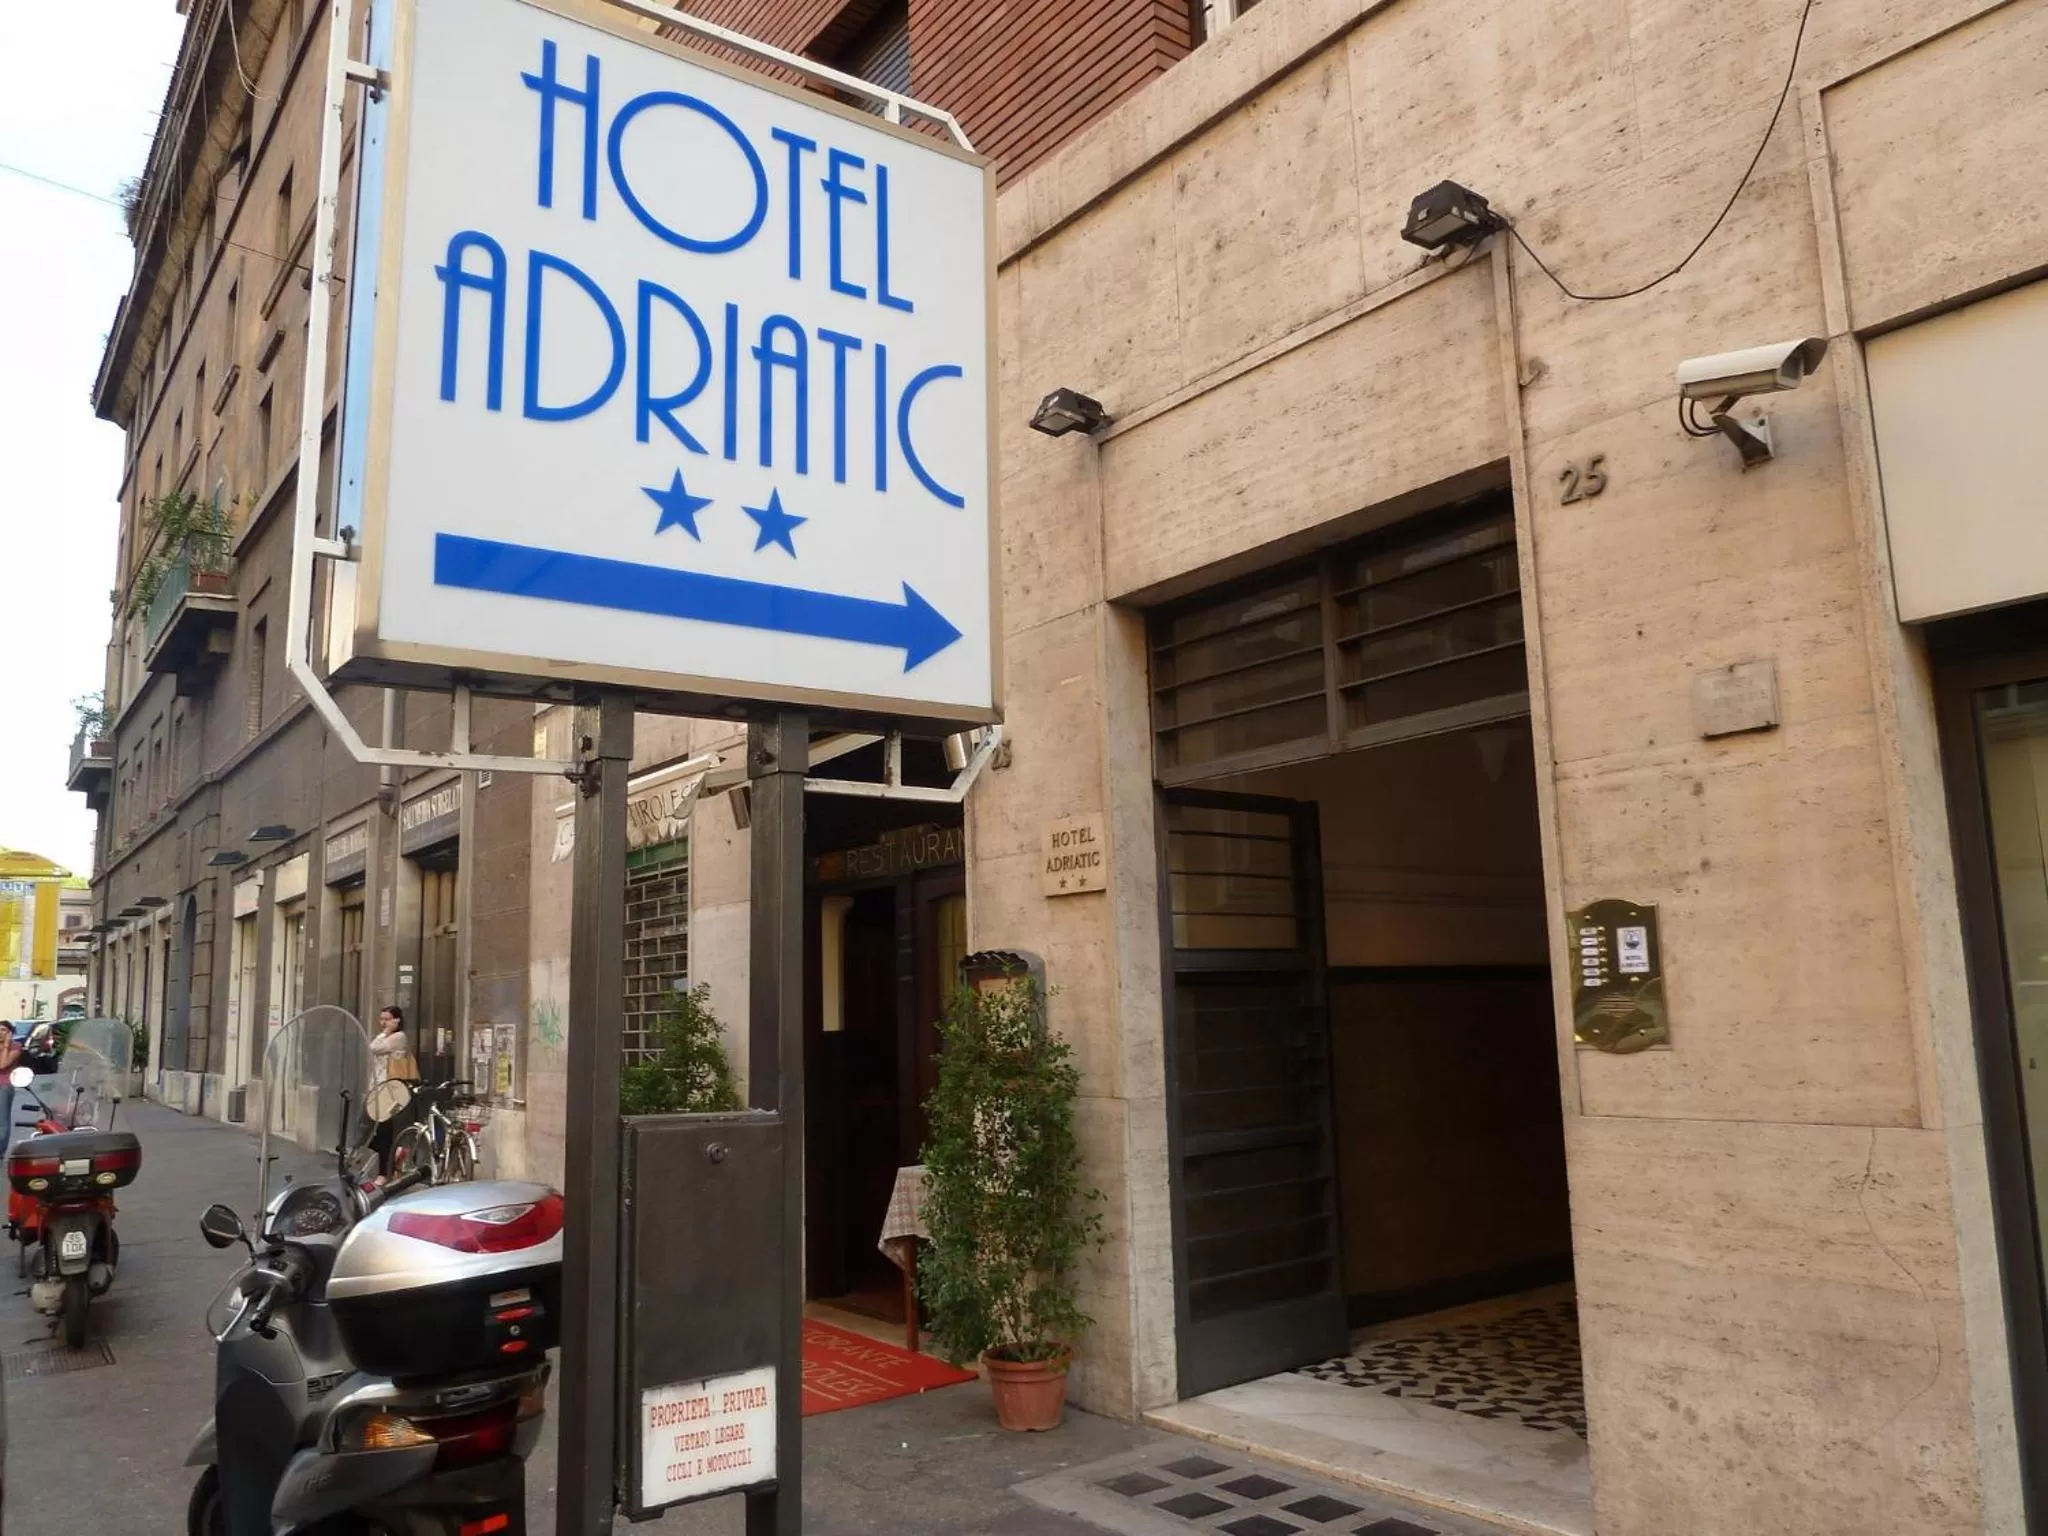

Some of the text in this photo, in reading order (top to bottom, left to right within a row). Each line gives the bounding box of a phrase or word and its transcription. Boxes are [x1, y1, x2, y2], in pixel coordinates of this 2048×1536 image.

[519, 38, 914, 313] HOTEL
[434, 230, 965, 509] ADRIATIC
[1559, 454, 1608, 506] 25
[1051, 827, 1096, 849] HOTEL
[1045, 851, 1101, 874] ADRIATIC
[722, 1385, 768, 1414] PRIVATA
[697, 1457, 704, 1476] E
